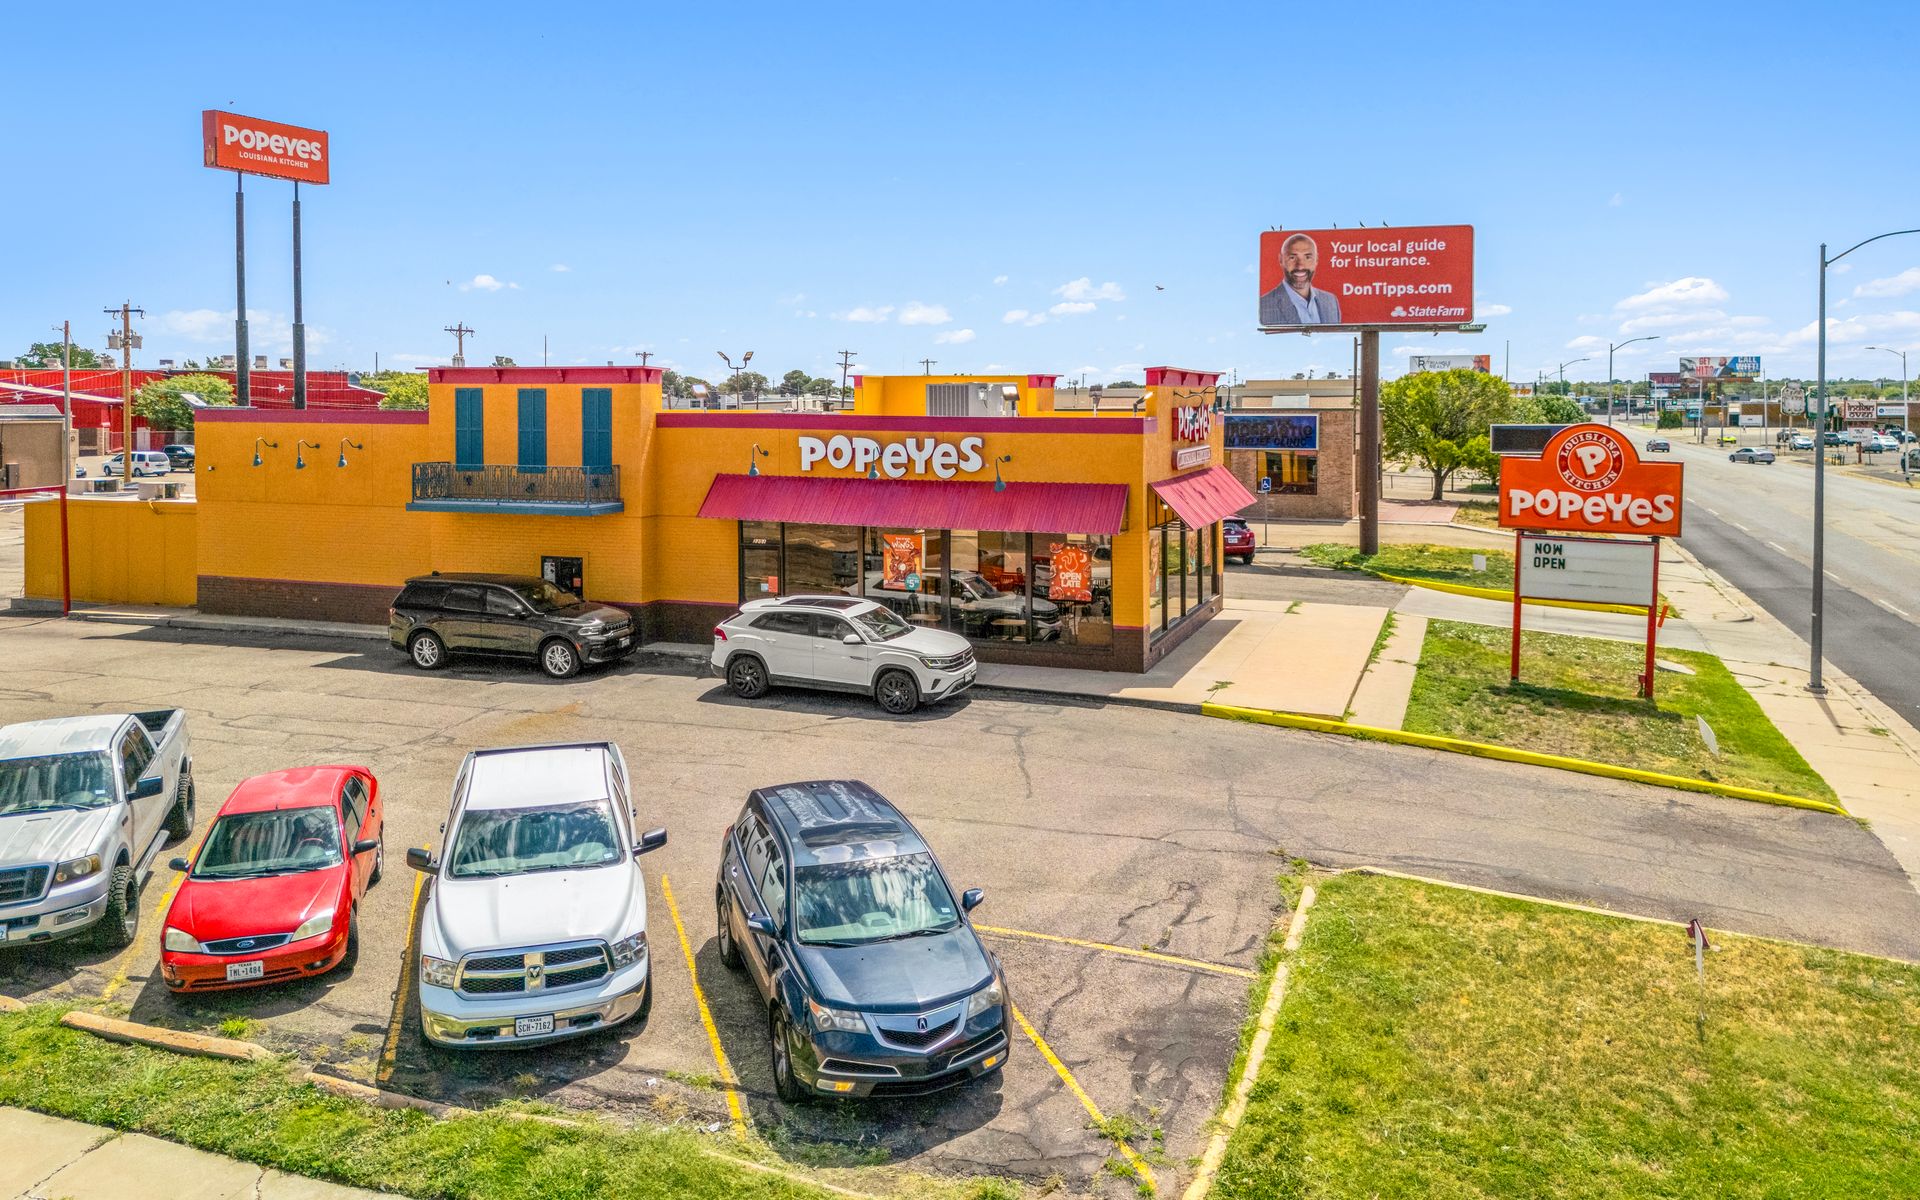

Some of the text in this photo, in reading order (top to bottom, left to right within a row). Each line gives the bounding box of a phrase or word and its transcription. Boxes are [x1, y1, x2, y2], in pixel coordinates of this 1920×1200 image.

[239, 151, 309, 168] LOUISIANA KITCHEN
[1330, 239, 1446, 254] Your local guide
[1330, 255, 1430, 268] for insurance.
[1343, 282, 1452, 297] DonTipps.com
[1560, 432, 1620, 458] LOUISIANA
[1575, 445, 1606, 476] P
[1562, 470, 1618, 490] KITCHEN
[1534, 543, 1563, 555] NOW
[1533, 556, 1566, 570] OPEN
[1060, 572, 1081, 580] OPEN
[1061, 580, 1081, 588] LATE
